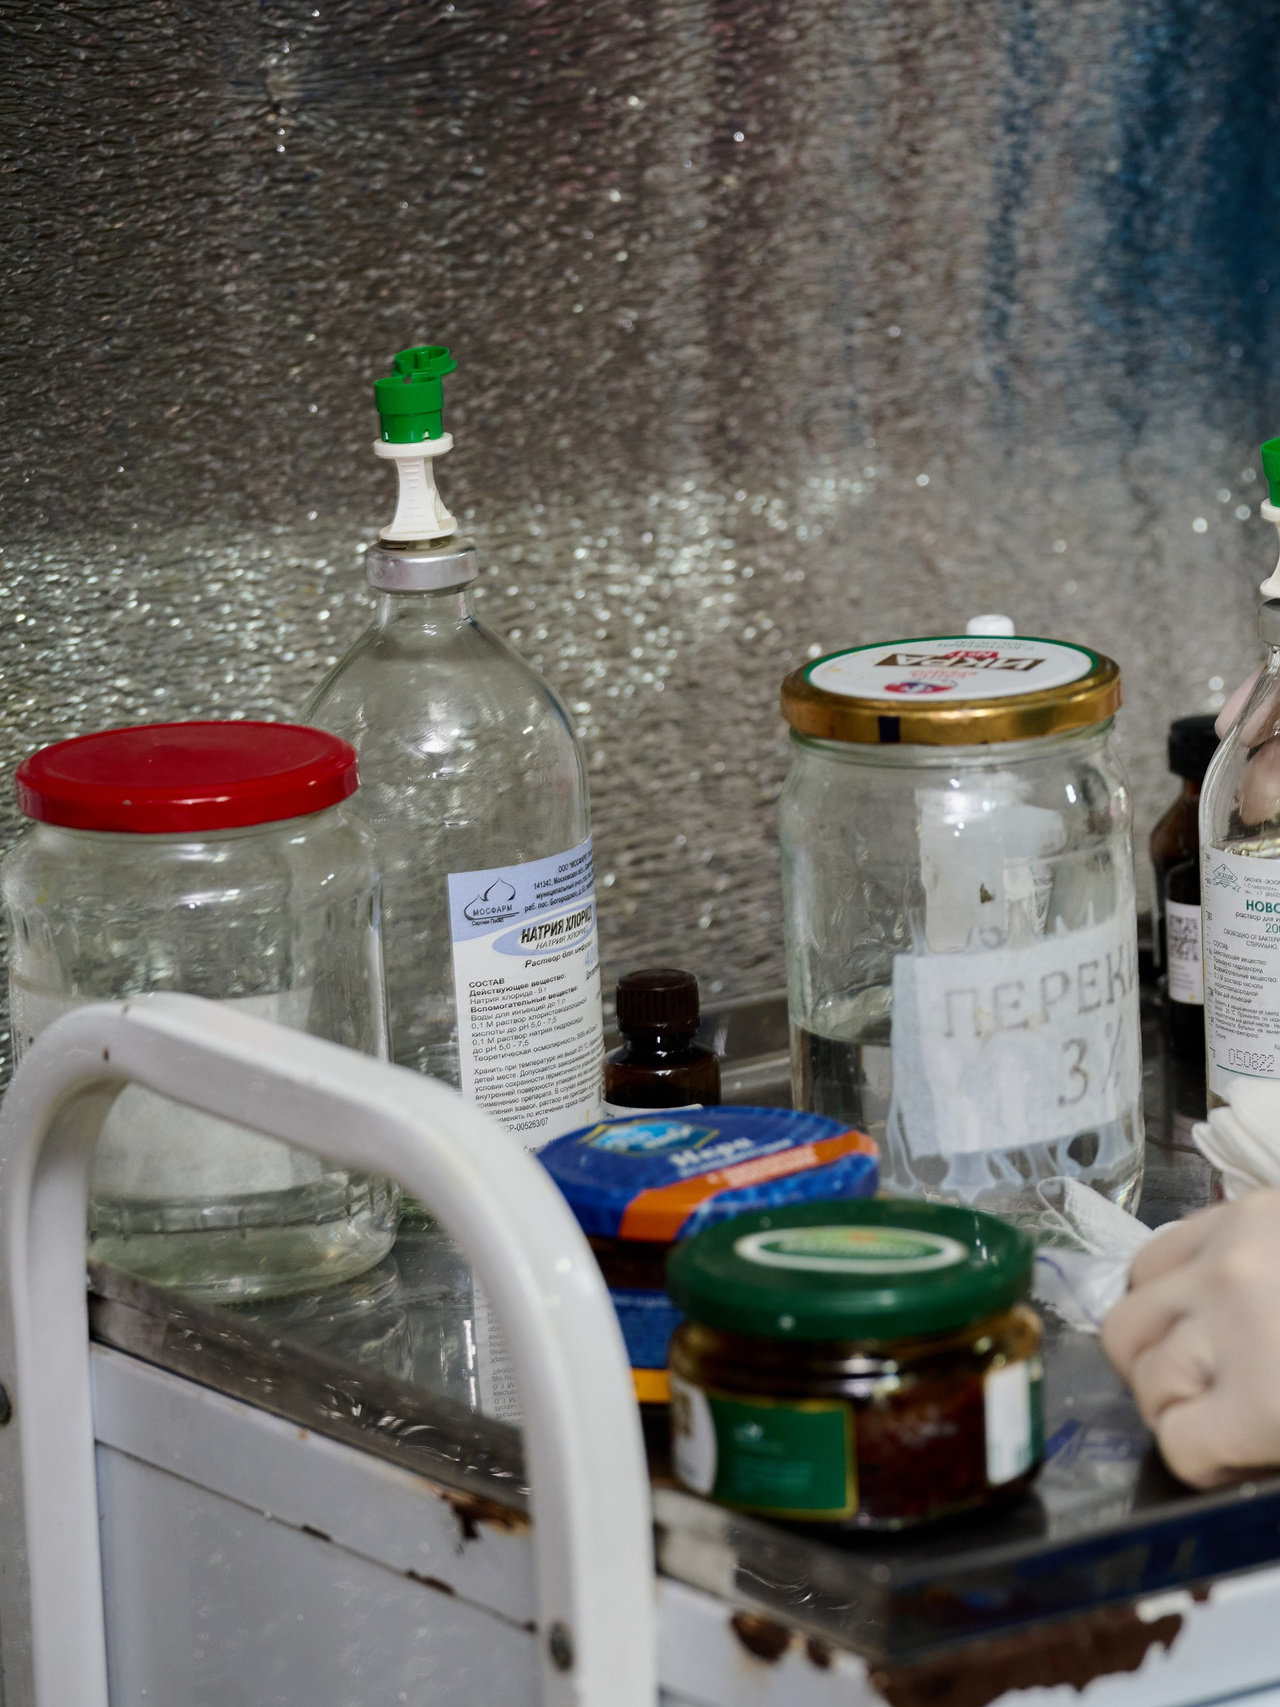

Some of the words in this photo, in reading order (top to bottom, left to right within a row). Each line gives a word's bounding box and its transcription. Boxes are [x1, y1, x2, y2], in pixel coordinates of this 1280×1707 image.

[893, 653, 1036, 670] ИКРА
[473, 904, 513, 917] МОСФАРМ
[1235, 911, 1262, 922] раствор
[521, 918, 564, 944] НАТРИЯ
[1223, 928, 1250, 939] СВОБОДНО
[536, 936, 566, 950] НАТРИЯ
[524, 953, 561, 968] Раствор
[562, 947, 574, 958] для
[469, 978, 505, 988] СОСТАВ
[469, 984, 529, 997] Действующее
[531, 973, 567, 987] вещество:
[470, 996, 499, 1004] Натрия
[502, 990, 533, 1000] хлорида
[471, 996, 546, 1013] Вспомогательные
[496, 1016, 526, 1028] раствор
[472, 1028, 505, 1037] кислоты
[507, 1026, 517, 1034] до
[496, 1032, 527, 1044] раствор
[529, 1026, 552, 1037] натрия
[473, 1047, 483, 1055] до
[473, 1048, 532, 1062] Теоретическая
[1228, 1047, 1275, 1072] 050822
[474, 1066, 503, 1076] Хранить
[505, 1064, 516, 1072] при
[474, 1075, 495, 1085] детей
[475, 1083, 504, 1094] условии
[503, 1116, 549, 1133] СР-005263/07
